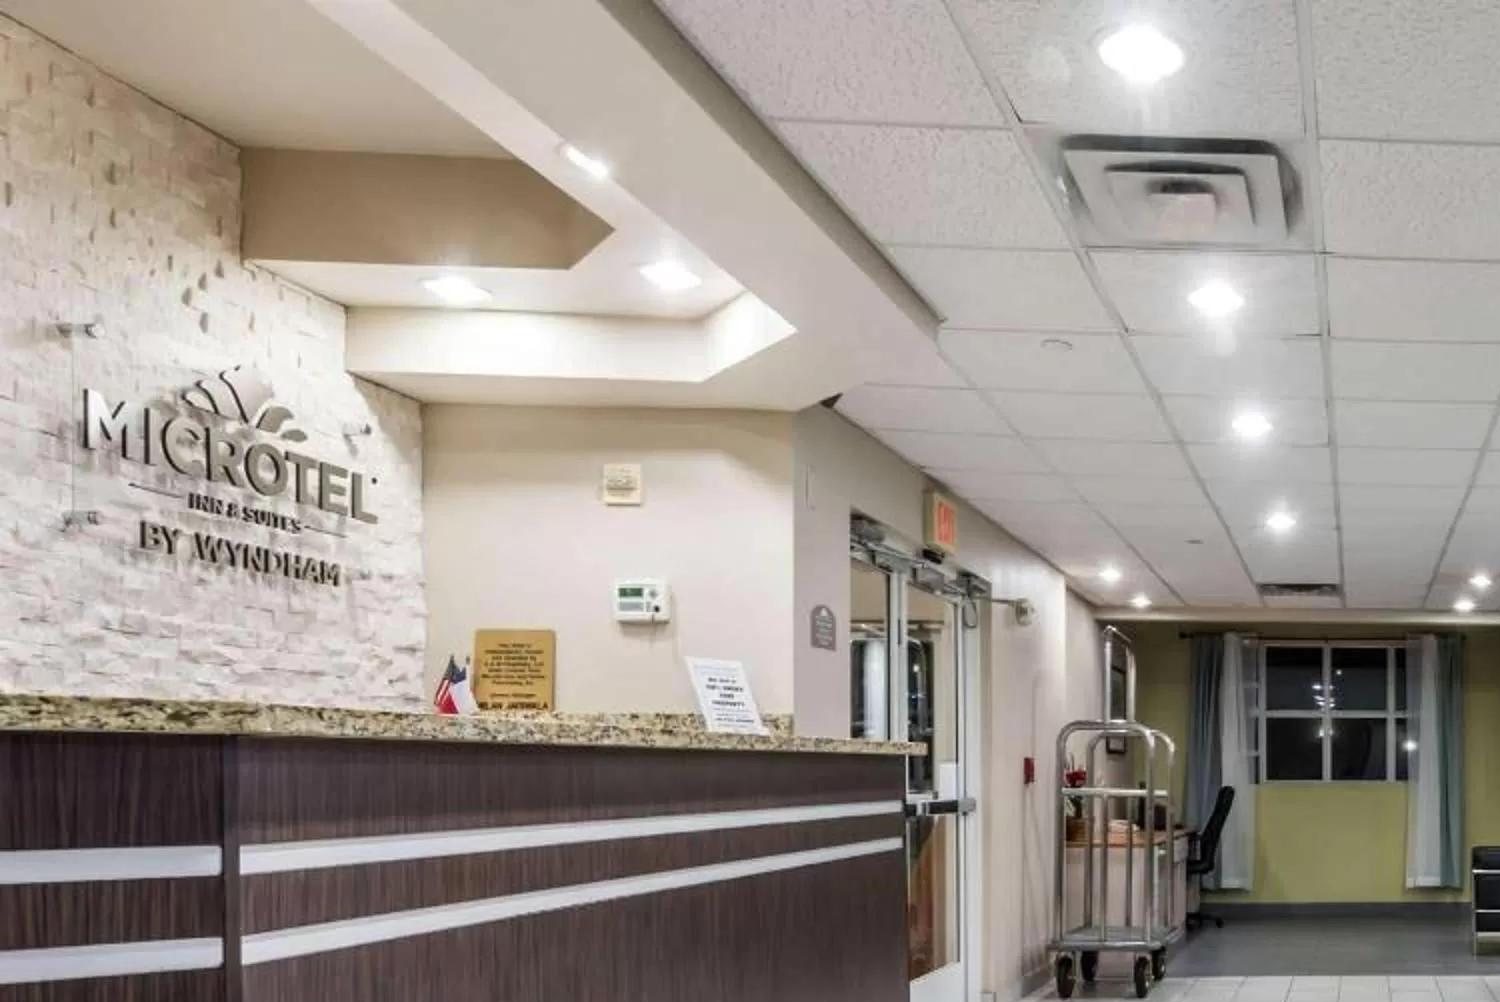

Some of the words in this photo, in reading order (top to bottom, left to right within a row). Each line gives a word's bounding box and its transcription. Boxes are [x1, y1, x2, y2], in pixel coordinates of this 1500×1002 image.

[82, 388, 379, 525] MICROTEL
[188, 492, 223, 515] INN
[226, 502, 239, 518] &
[241, 506, 302, 534] SUITES
[140, 520, 180, 557] BY
[194, 532, 341, 587] WYNDHAM
